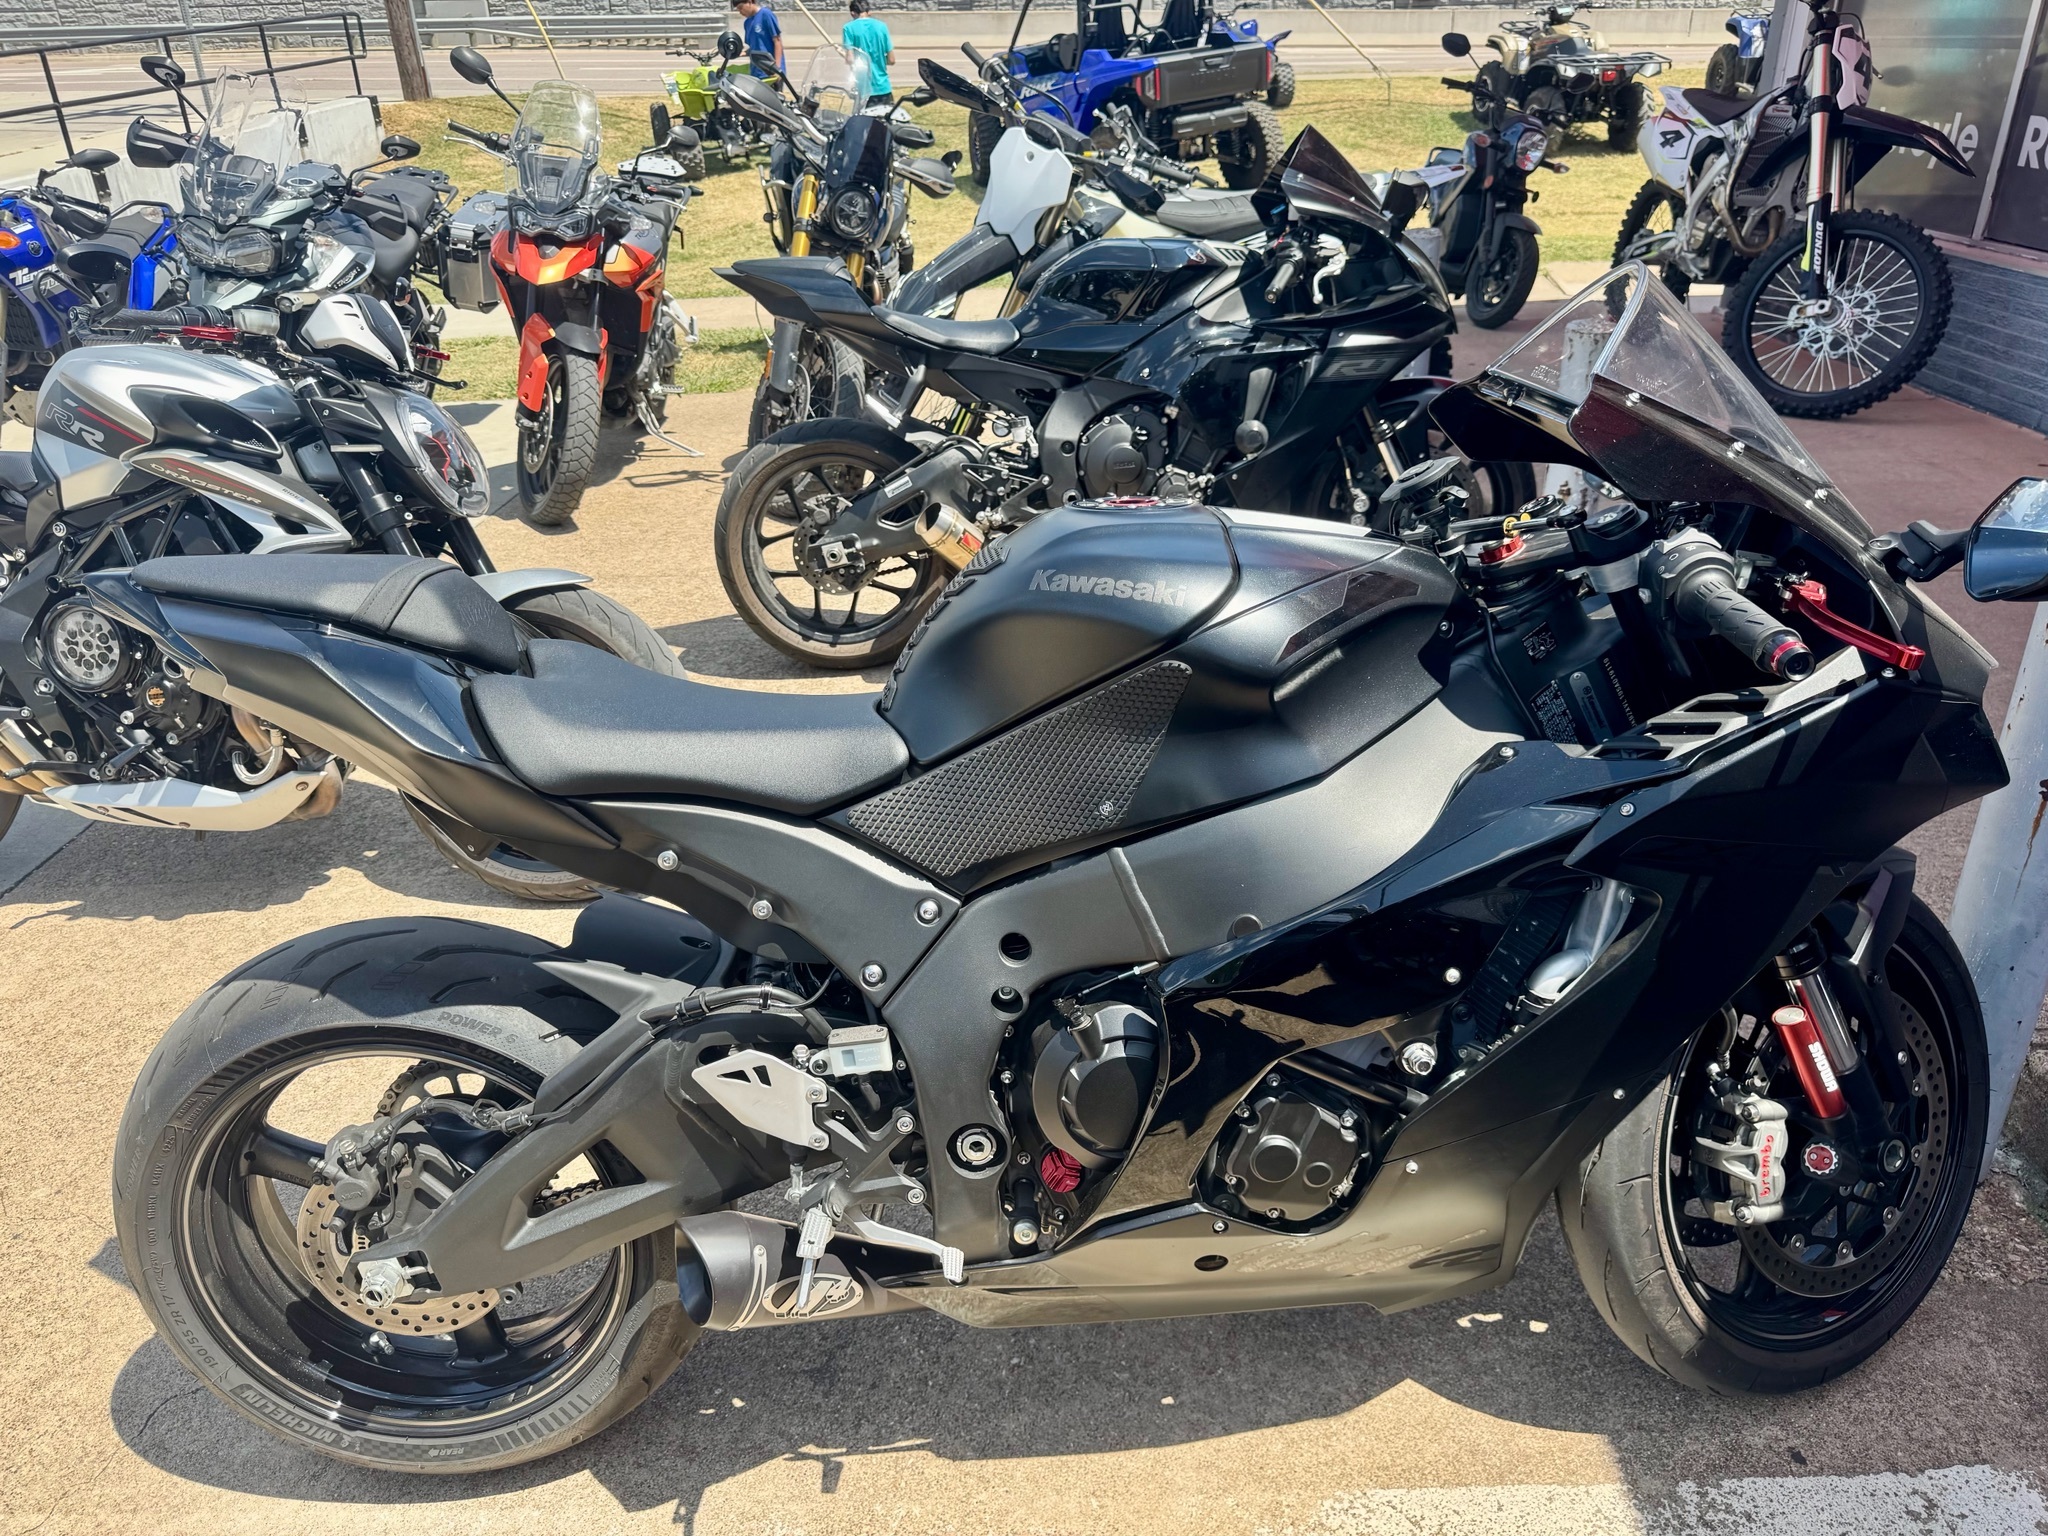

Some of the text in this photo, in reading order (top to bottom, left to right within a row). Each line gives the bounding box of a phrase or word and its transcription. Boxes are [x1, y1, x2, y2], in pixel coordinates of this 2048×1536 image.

[1854, 52, 1871, 91] 4
[1659, 130, 1685, 149] 4
[1813, 220, 1824, 275] DUNLOP
[45, 402, 107, 453] RR
[149, 463, 262, 505] DRAGSTER
[1028, 569, 1187, 607] Kawasaki
[438, 1011, 502, 1038] POWER
[1808, 1041, 1839, 1093] SHOWA
[1760, 1135, 1774, 1197] brembo
[162, 1295, 175, 1308] 17
[170, 1310, 187, 1326] ZR
[182, 1329, 219, 1369] 190/55
[240, 1389, 337, 1443] MICHELIN
[439, 1447, 464, 1457] REAR
